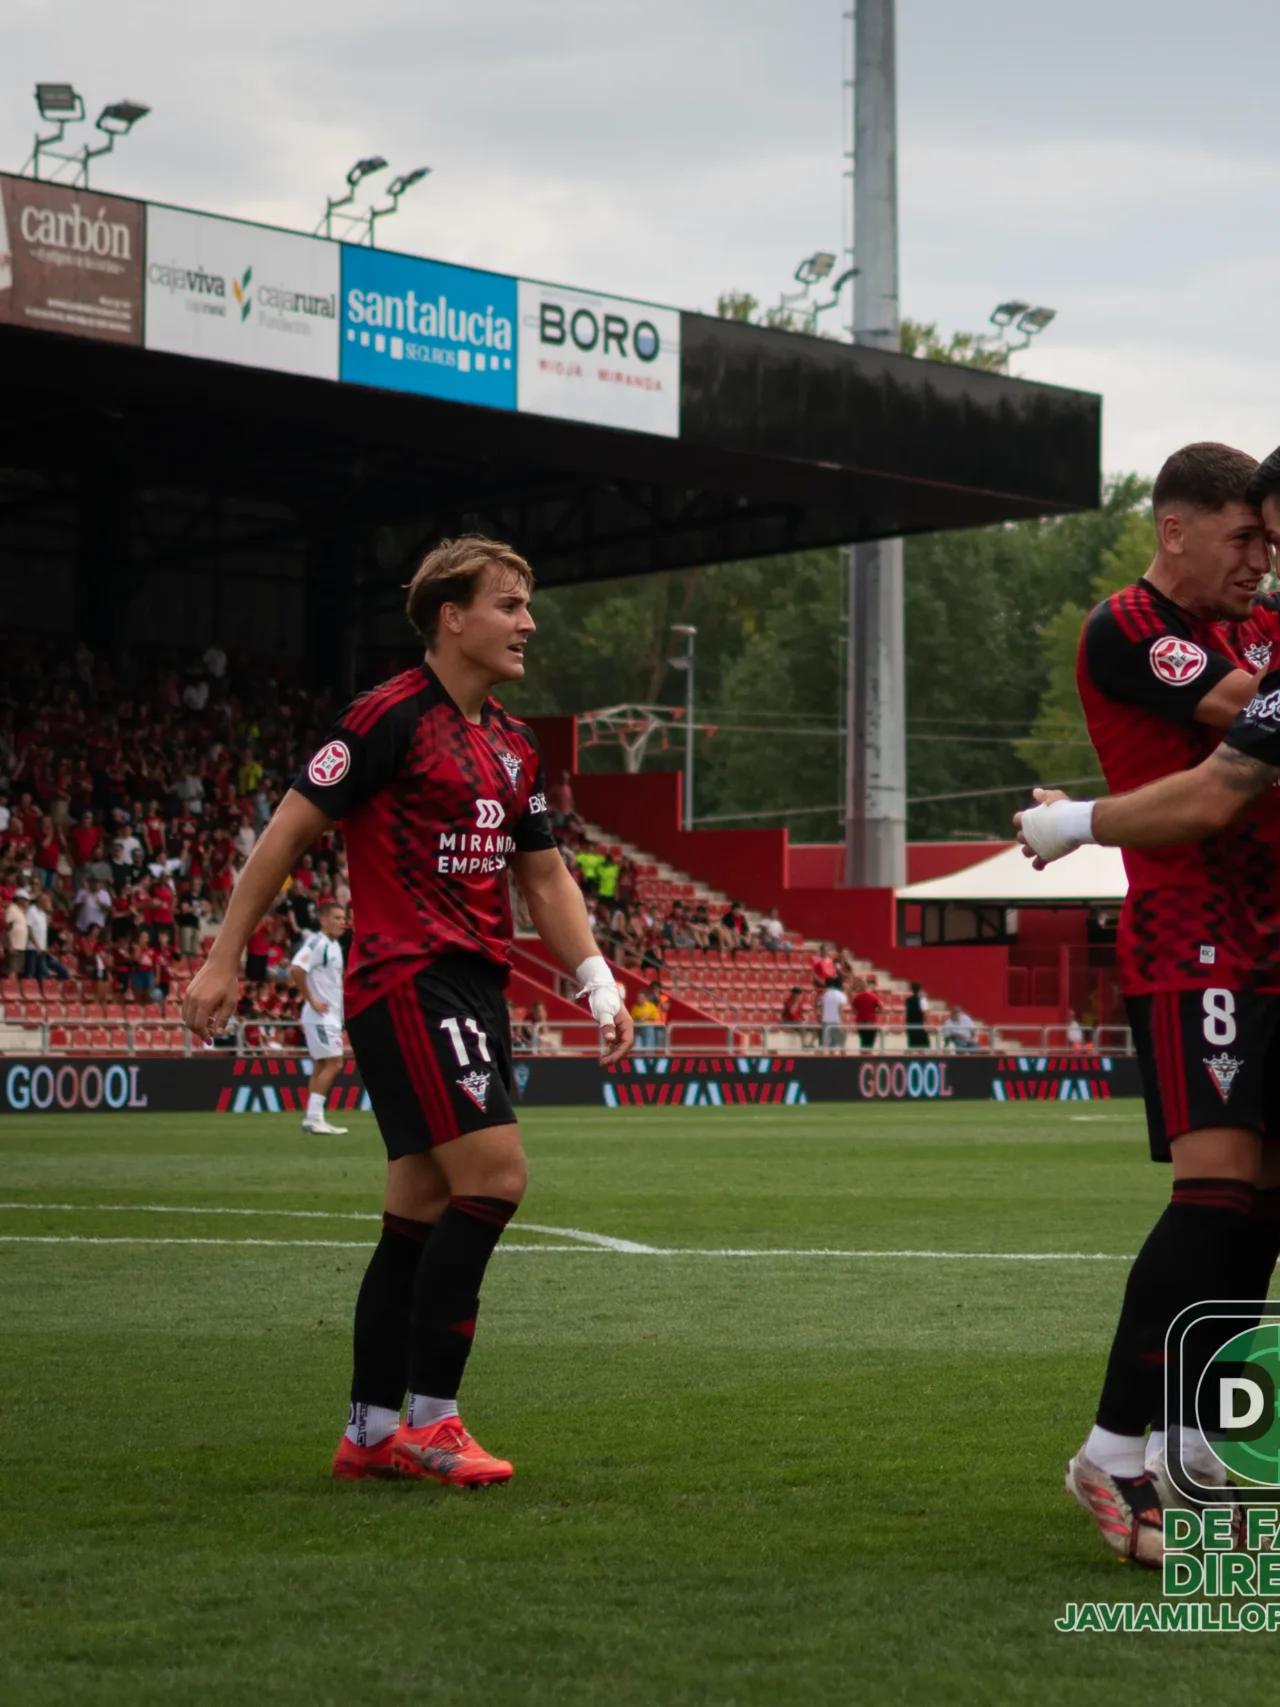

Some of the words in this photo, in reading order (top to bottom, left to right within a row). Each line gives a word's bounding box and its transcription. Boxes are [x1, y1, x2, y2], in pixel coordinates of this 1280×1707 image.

[21, 203, 131, 260] carbón
[149, 259, 226, 298] cajaviva
[258, 283, 336, 320] cajarural
[348, 288, 513, 351] santalucía
[540, 302, 661, 364] BORO
[405, 342, 456, 367] SEGUROS
[539, 358, 582, 377] RIOJA
[597, 368, 663, 393] MIRANDA
[440, 832, 516, 853] MIRANDA
[438, 855, 506, 874] EMPRESA
[1203, 988, 1236, 1045] 8
[6, 1064, 148, 1109] GOOOOL
[859, 1062, 953, 1097] GOOOOL
